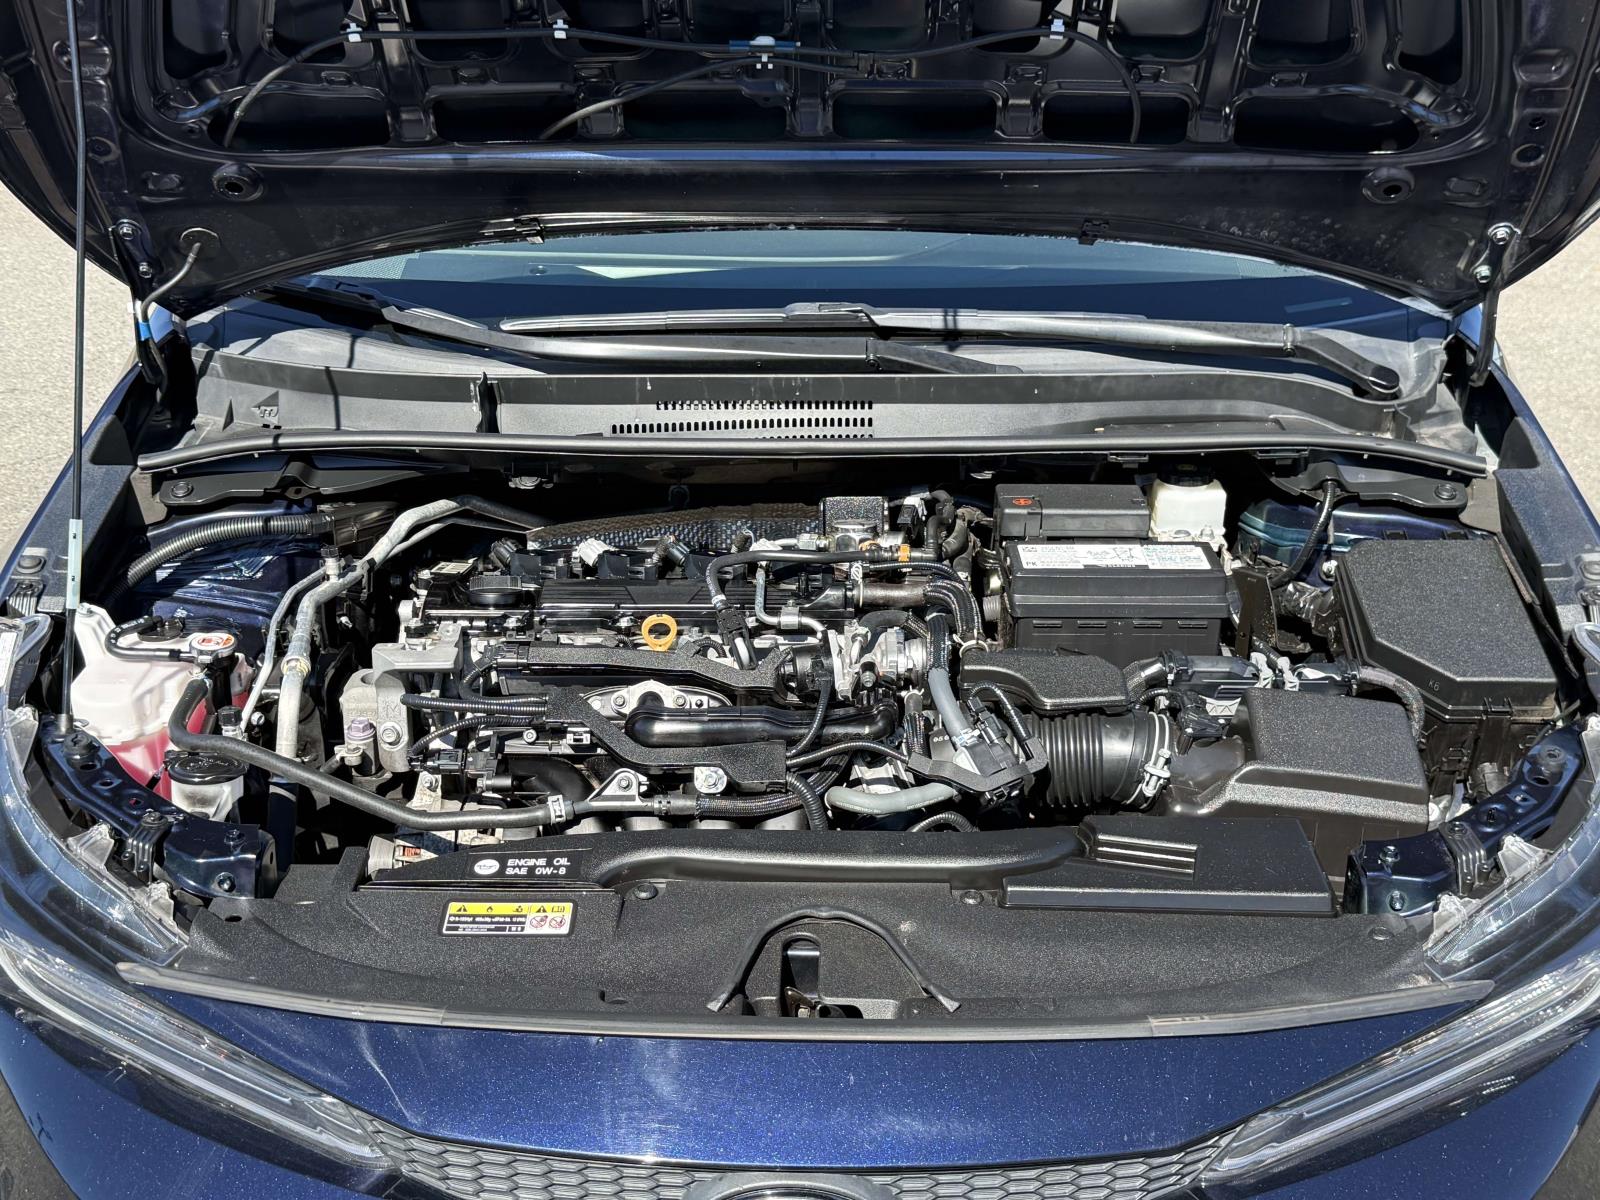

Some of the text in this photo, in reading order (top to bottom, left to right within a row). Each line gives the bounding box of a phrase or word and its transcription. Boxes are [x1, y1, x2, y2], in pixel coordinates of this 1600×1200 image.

[507, 857, 571, 866] ENGINE OIL
[505, 866, 566, 875] SAE 0W-8
